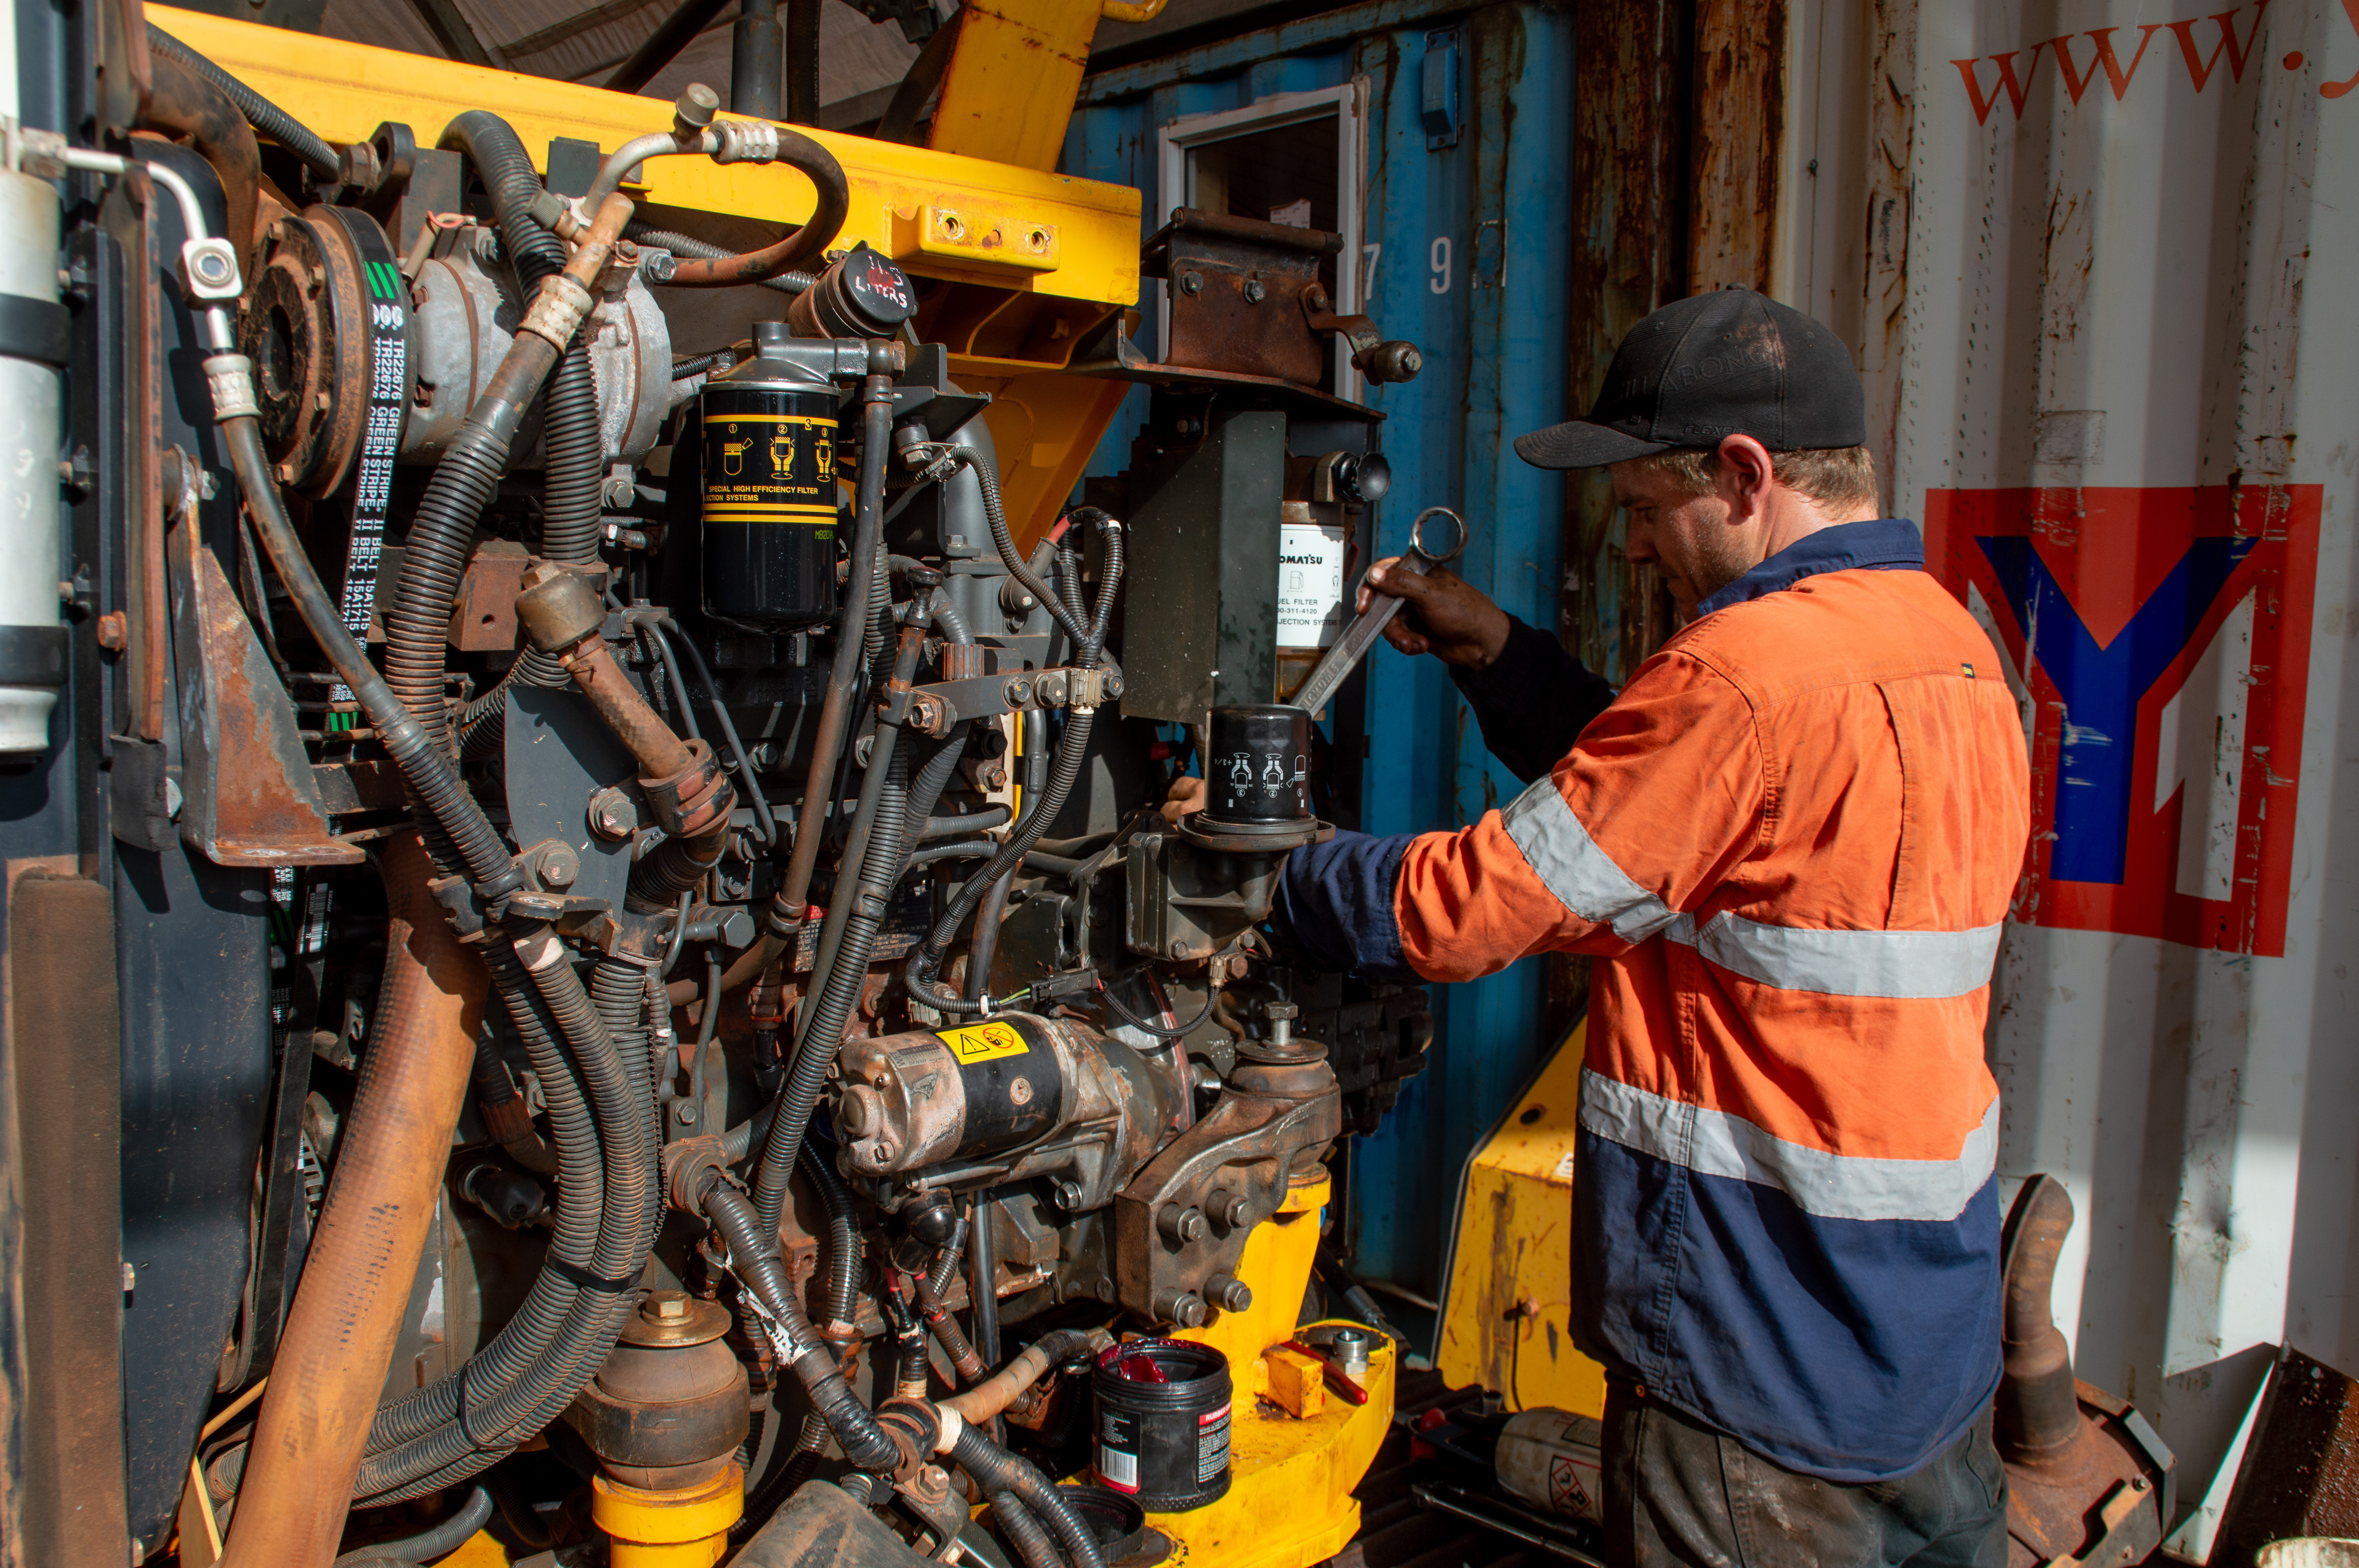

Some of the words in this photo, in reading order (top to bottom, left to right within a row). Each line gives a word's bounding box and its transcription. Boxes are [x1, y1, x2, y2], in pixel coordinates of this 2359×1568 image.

[1430, 236, 1452, 294] 9
[380, 337, 394, 399] TR22676
[392, 339, 405, 400] TR22676
[373, 406, 389, 456] GREEN
[385, 407, 401, 456] GREEN
[357, 537, 371, 571] BELT
[368, 537, 382, 572] BELT
[1279, 554, 1323, 564] OMATSU
[349, 579, 366, 631] 15A1715
[1205, 1408, 1226, 1421] RUBBER
